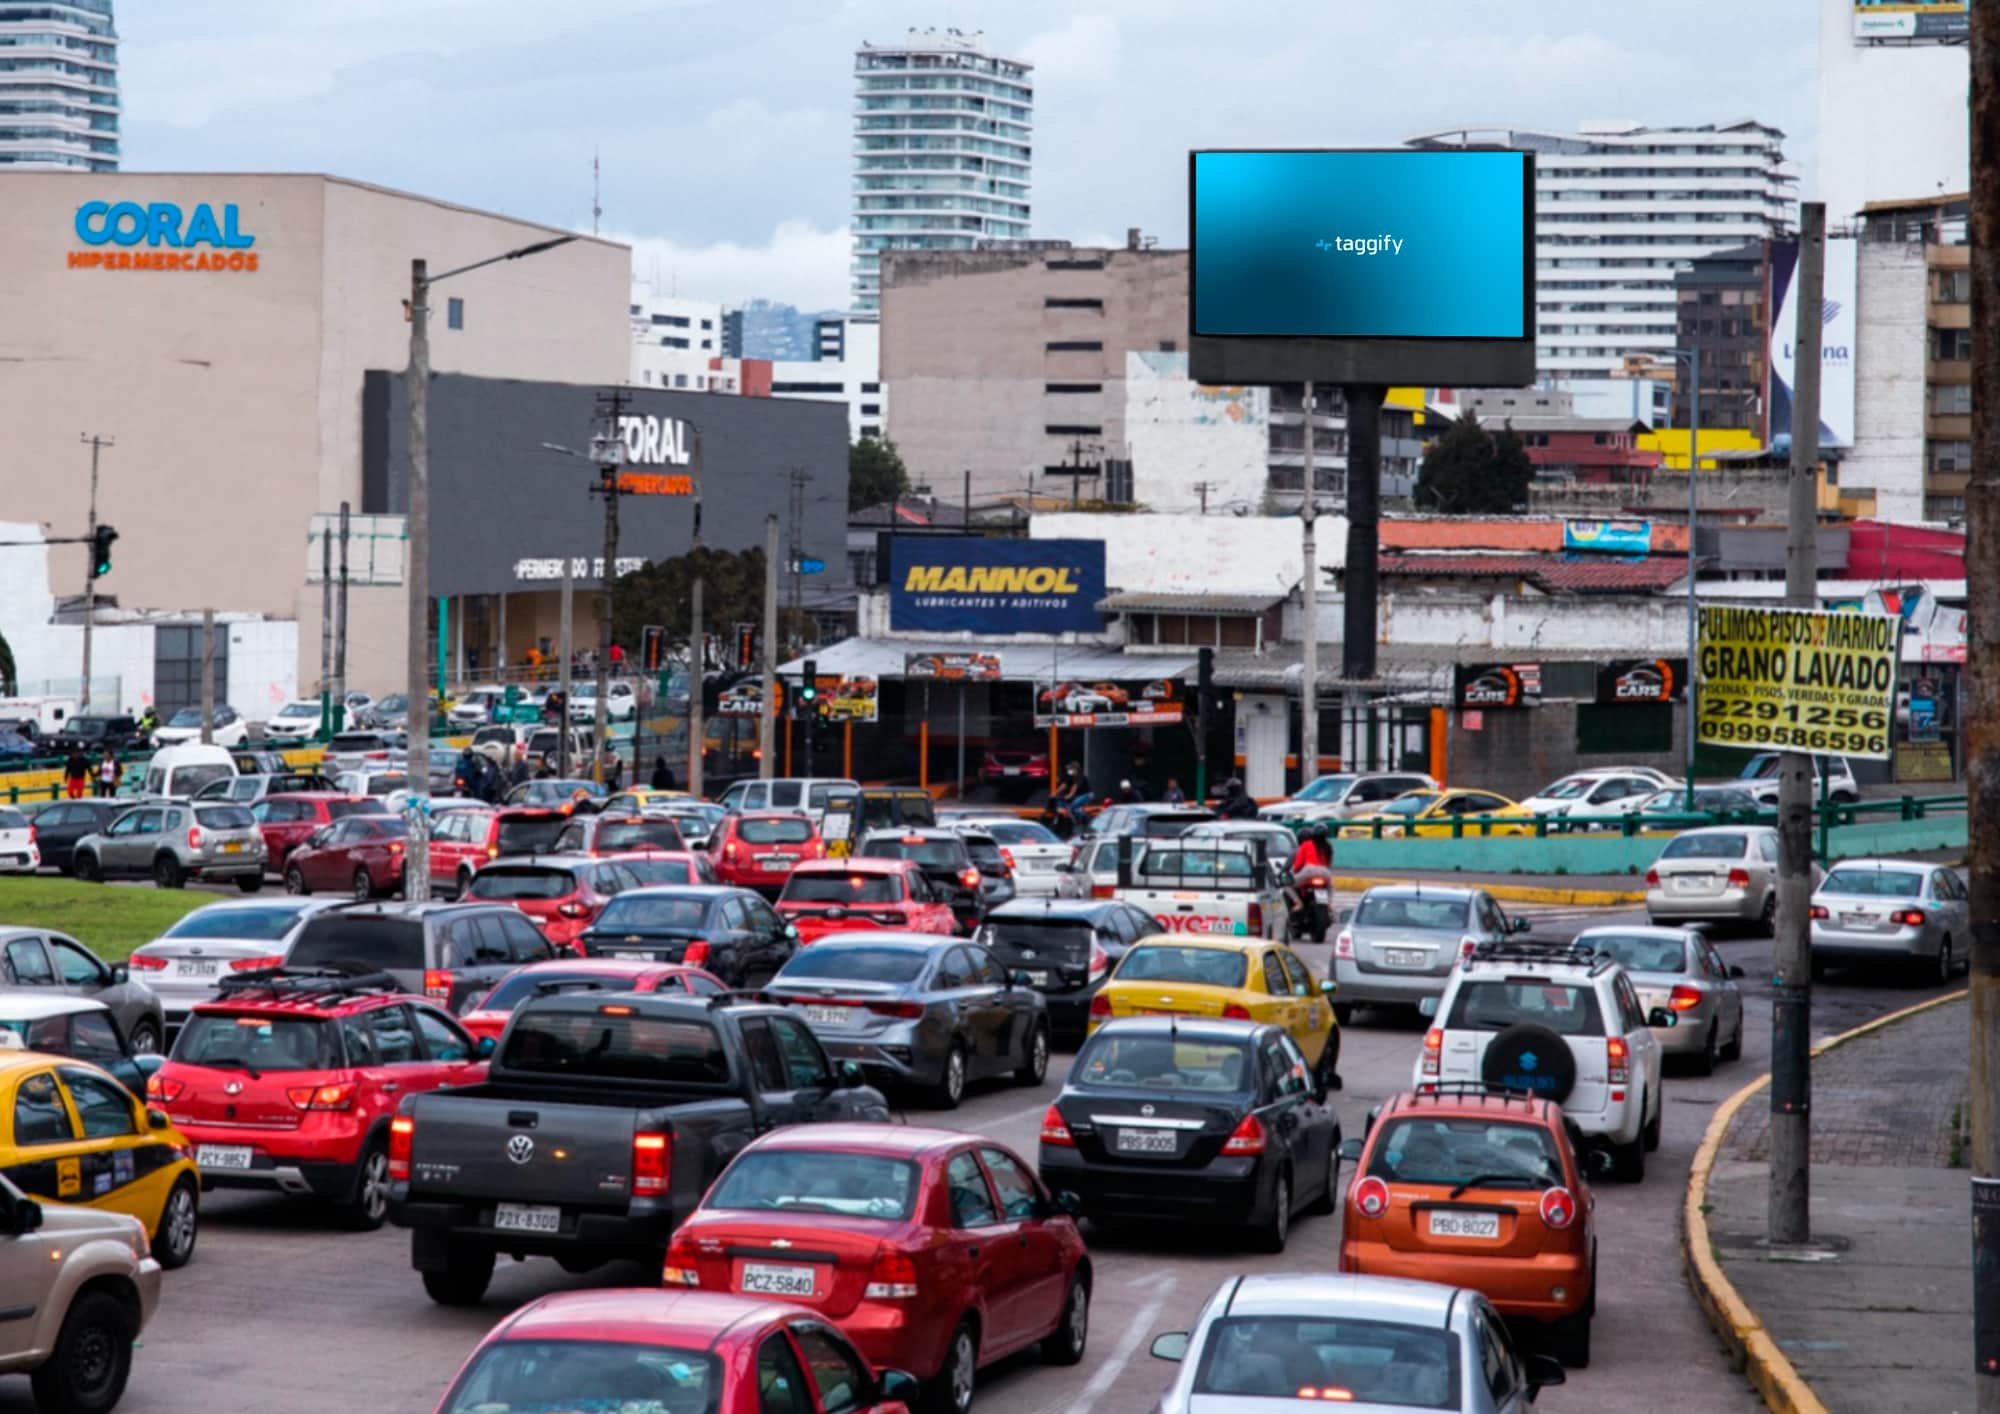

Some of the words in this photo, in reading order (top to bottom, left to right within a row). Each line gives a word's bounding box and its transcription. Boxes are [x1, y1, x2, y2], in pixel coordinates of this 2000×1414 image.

[75, 200, 255, 248] CORAL
[1334, 234, 1404, 256] taggify
[67, 252, 259, 271] HIPERMERCADOS
[903, 565, 1079, 594] MANNOL
[915, 597, 995, 608] LUBRICANTES
[1000, 598, 1007, 608] Y
[1011, 598, 1068, 609] ADITIVOS
[1698, 607, 1766, 642] PULIMOS
[1770, 610, 1812, 645] PISOS
[1827, 613, 1894, 652] MARMOL
[1701, 646, 1786, 682] GRANO
[1793, 650, 1890, 692] LAVADO
[1465, 691, 1507, 702] CARS
[1616, 685, 1661, 697] CARS
[1788, 688, 1836, 703] VEREDAS
[1838, 692, 1844, 704] Y
[1846, 694, 1890, 707] GRADAS
[1704, 699, 1887, 730] 2291256
[1700, 721, 1886, 753] 0999586596
[745, 1273, 812, 1293] PCZ-5840
